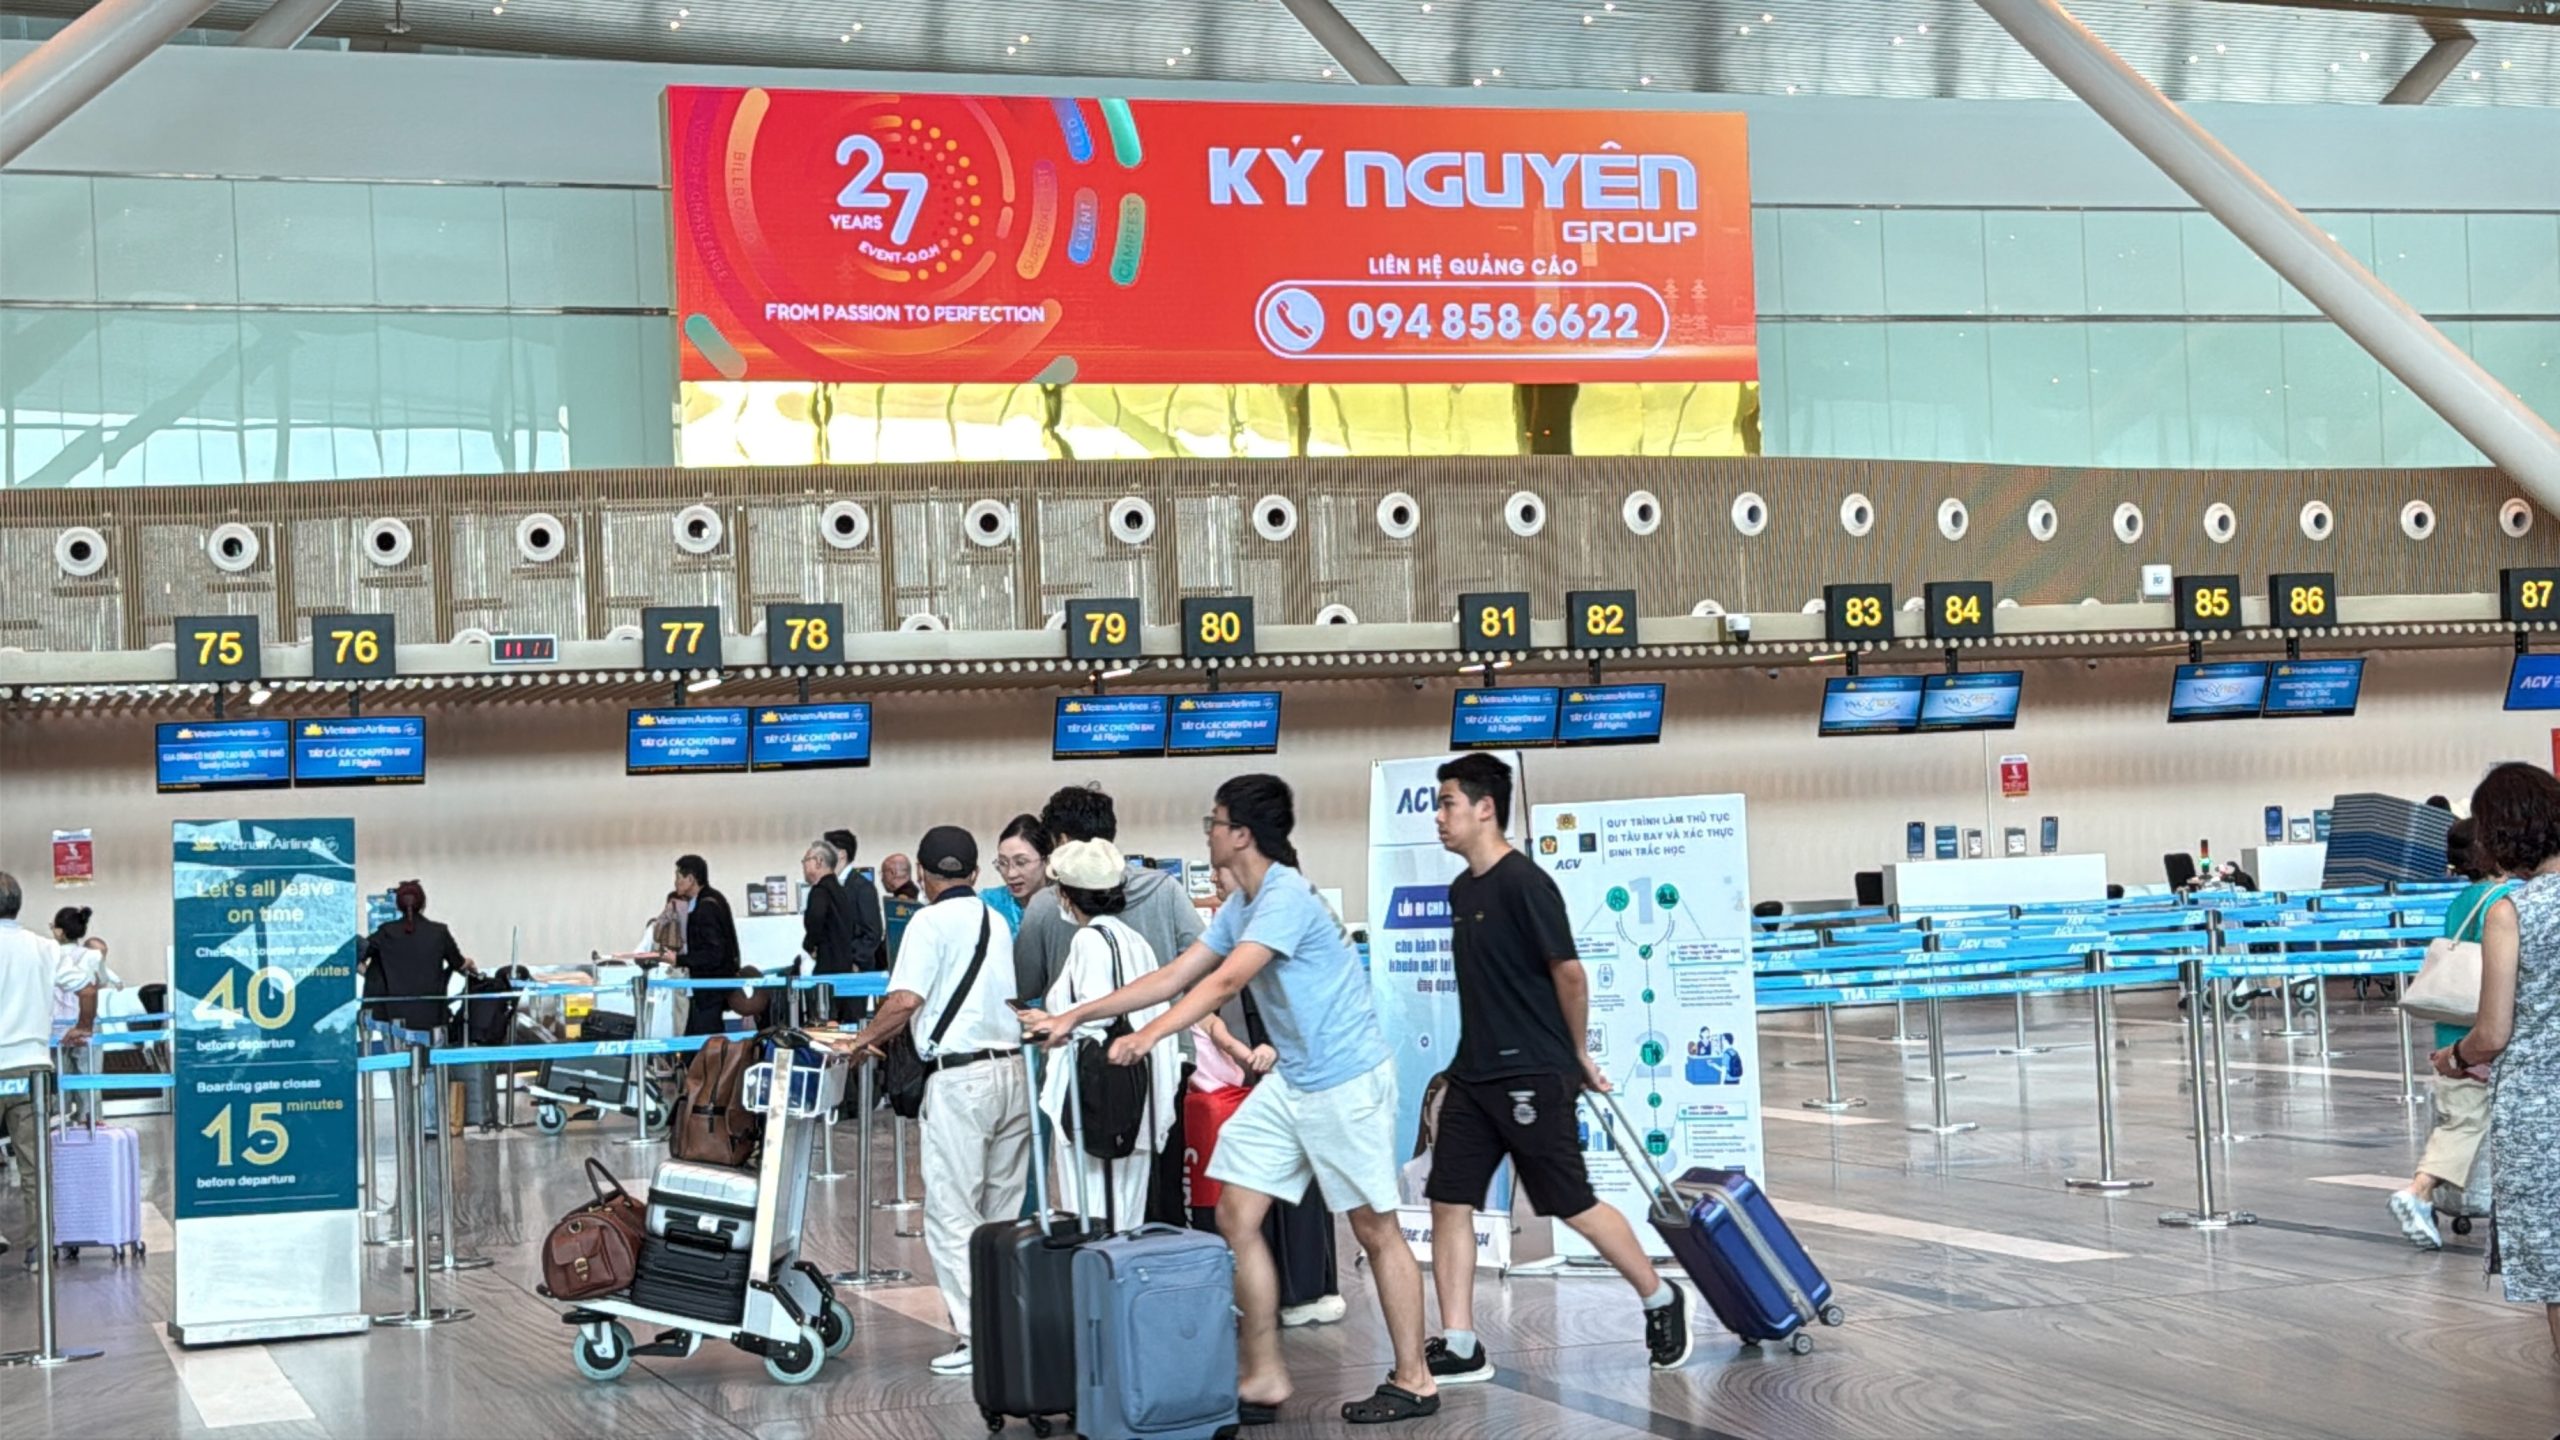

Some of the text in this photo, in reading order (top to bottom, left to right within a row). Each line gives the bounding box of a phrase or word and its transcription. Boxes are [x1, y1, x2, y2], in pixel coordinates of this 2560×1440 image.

[1068, 119, 1085, 147] LED
[1345, 140, 1698, 210] NGUYÊN
[835, 134, 929, 245] 27
[830, 213, 883, 230] YEARS
[1075, 203, 1092, 252] EVENT
[1563, 221, 1697, 243] GROUP
[1119, 199, 1140, 279] CAMPFEST
[1368, 252, 1578, 280] LIÊN HỆ QUẢNG CÁO
[765, 303, 1045, 322] FROM PASSION TO PERFECTION
[1349, 302, 1639, 340] 094 858 6622
[2195, 588, 2230, 617] 85
[2290, 586, 2325, 615] 86
[2521, 580, 2553, 609] 87
[1481, 606, 1515, 637] 81
[1587, 604, 1624, 634] 82
[1846, 597, 1882, 627] 83
[1945, 595, 1981, 625] 84
[661, 621, 704, 654] 77
[785, 618, 829, 651] 78
[1086, 612, 1126, 644] 79
[1201, 611, 1240, 643] 80
[194, 631, 243, 665] 75
[331, 630, 379, 664] 76
[2520, 675, 2552, 689] ACV
[1607, 811, 1731, 829] QUY TRÌNH LÀM THỦ TỤC
[1608, 826, 1735, 843] ĐI TÀU BAY VÀ XÁC THỰC
[1555, 858, 1582, 871] ACV
[1609, 845, 1686, 858] SINH TRẮC HỌC
[195, 879, 334, 898] Let's all leave
[228, 907, 304, 923] on time
[294, 966, 350, 977] minutes
[1802, 973, 1833, 986] TIA
[192, 966, 296, 1029] 40
[1840, 986, 1868, 1000] TIA
[196, 1038, 296, 1052] before departure
[593, 1041, 628, 1054] ACV
[197, 1079, 321, 1094] Boarding gate closes
[287, 1098, 344, 1111] minutes
[201, 1102, 289, 1166] 15
[197, 1174, 296, 1188] before departure
